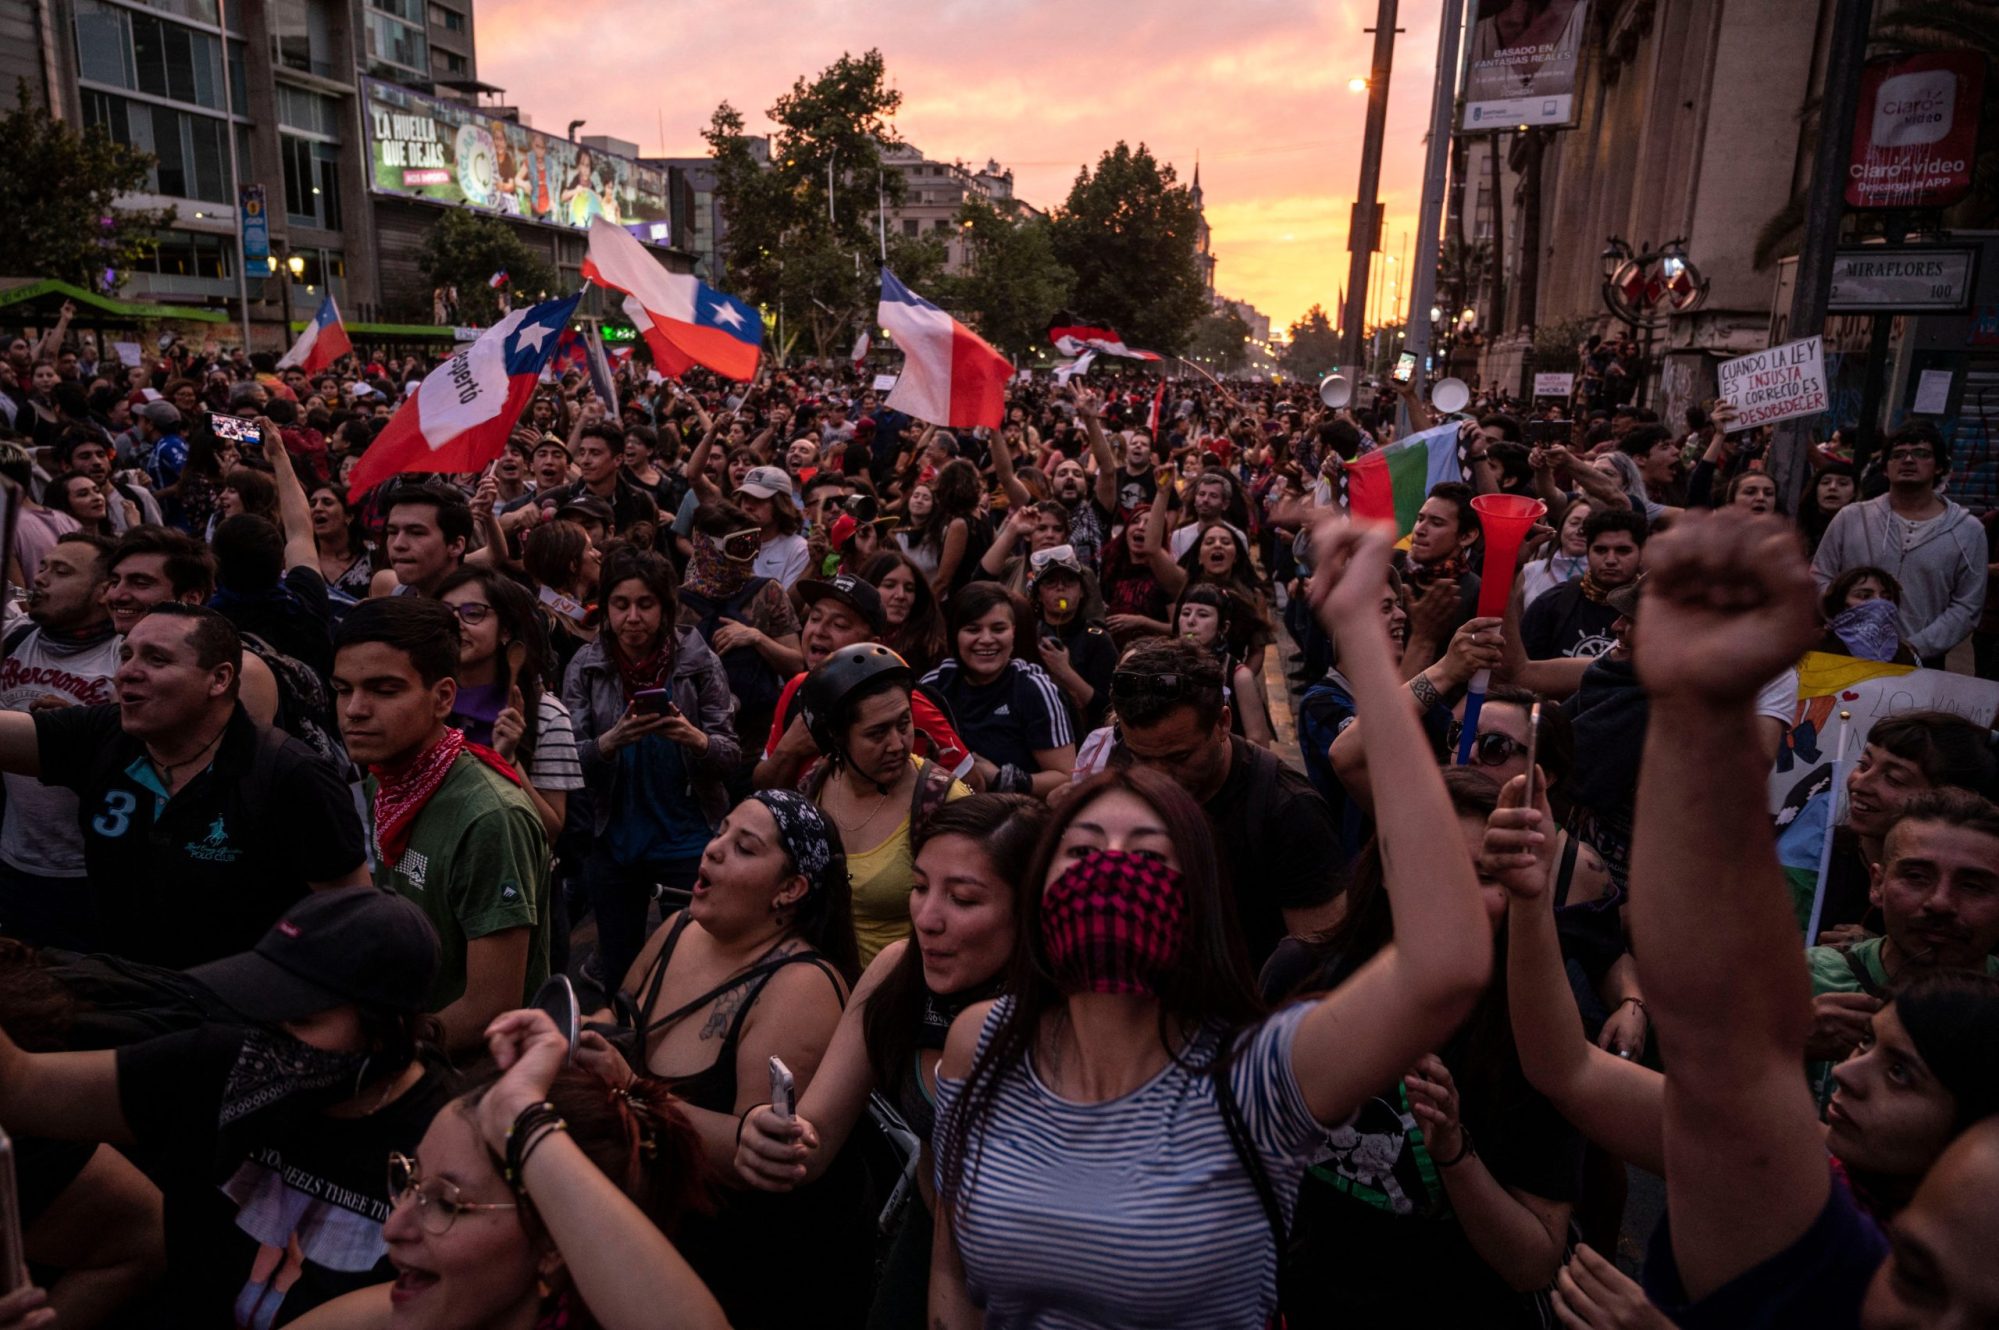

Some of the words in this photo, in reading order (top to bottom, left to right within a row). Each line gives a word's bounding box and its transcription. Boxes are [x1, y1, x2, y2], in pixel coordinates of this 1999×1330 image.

[1494, 45, 1536, 58] BASADO
[1538, 43, 1554, 53] EN
[1530, 50, 1570, 63] REALES
[1883, 98, 1934, 115] Claro
[374, 112, 392, 139] LA
[392, 114, 437, 142] HUELLA
[382, 140, 407, 166] QUE
[408, 142, 445, 168] DEJAS
[1850, 162, 1902, 179] Claro
[1912, 158, 1965, 174] video
[1858, 180, 1910, 194] Descarga
[1912, 180, 1924, 190] la
[1926, 177, 1952, 188] APP
[1845, 261, 1944, 277] MIRAFLORES
[1930, 284, 1952, 298] 100
[1721, 355, 1766, 380] CUANDO
[1772, 350, 1787, 368] LA
[1791, 340, 1816, 365] LEY
[447, 350, 484, 404] espertó
[1723, 380, 1740, 396] ES
[1748, 366, 1802, 390] INJUSTA
[1745, 382, 1800, 405] CORRECTO
[1803, 377, 1820, 394] ES
[1739, 392, 1824, 426] DESOBEDECER
[0, 657, 110, 705] Abercrombi
[92, 789, 136, 838] 3
[324, 1180, 370, 1214] THREE
